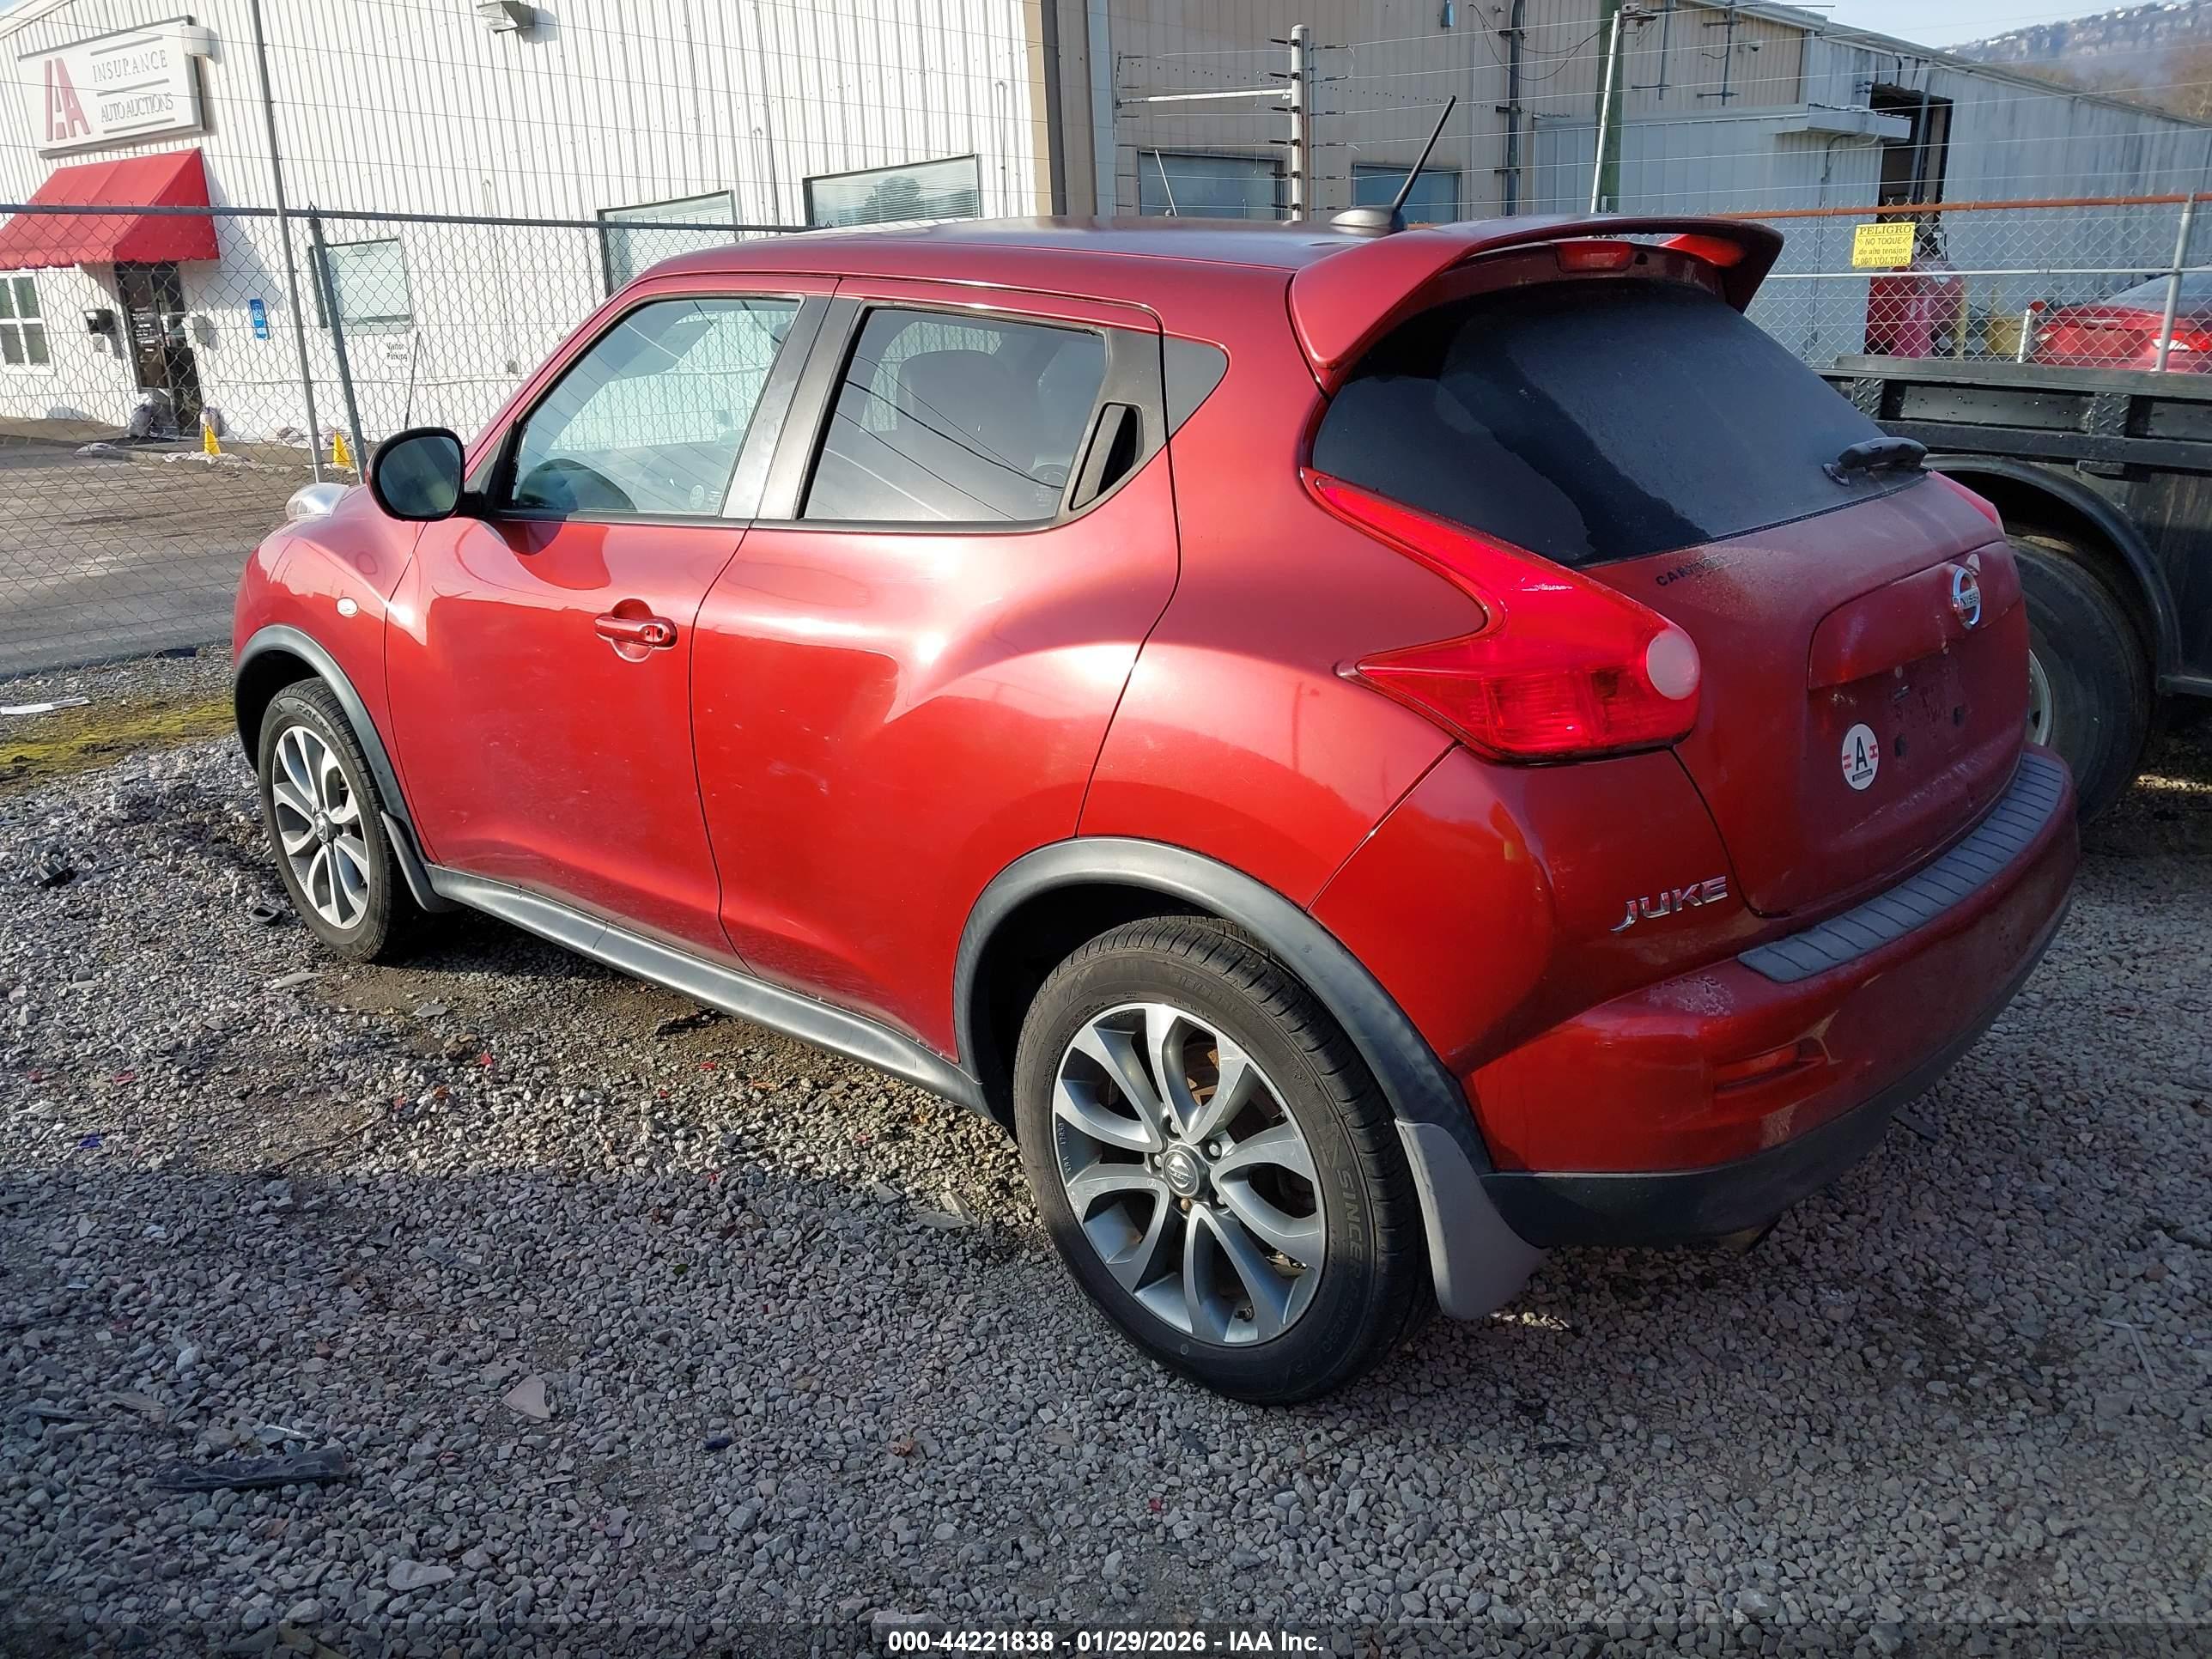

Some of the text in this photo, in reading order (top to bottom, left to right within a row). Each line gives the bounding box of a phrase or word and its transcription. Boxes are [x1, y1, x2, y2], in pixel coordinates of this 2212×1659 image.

[93, 50, 167, 82] INSURANCE
[100, 92, 173, 124] AUTO AUCTIONS
[1858, 225, 1911, 235] PELIGRO
[1865, 236, 1902, 246] NO TOQUE
[1874, 256, 1909, 265] VOLTIOS
[1610, 876, 1728, 932] JUKE
